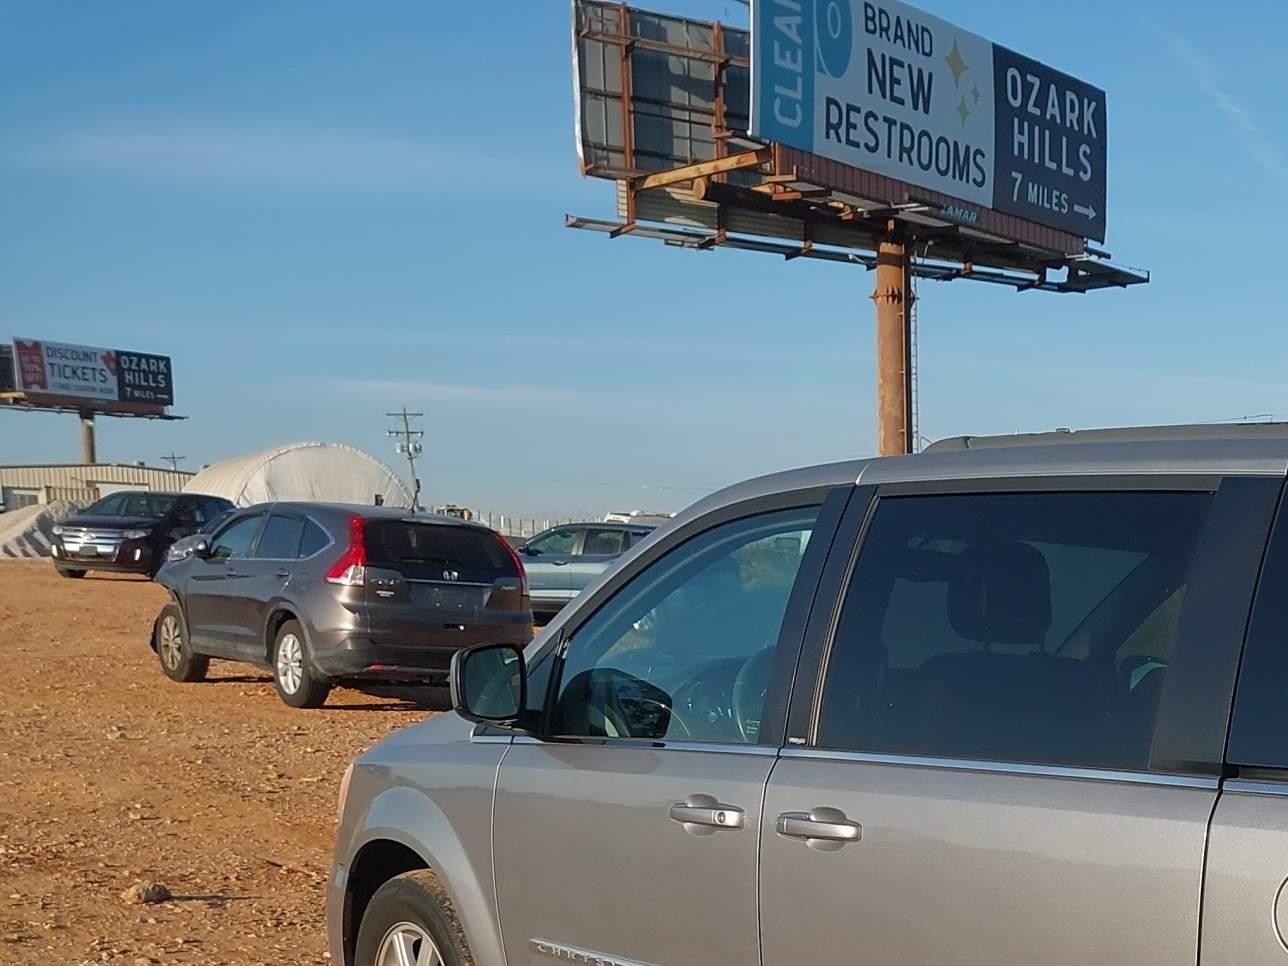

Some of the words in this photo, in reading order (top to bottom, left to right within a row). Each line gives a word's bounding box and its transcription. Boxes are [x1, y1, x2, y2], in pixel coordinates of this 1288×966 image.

[863, 2, 933, 57] BRAND
[866, 47, 933, 115] NEW
[1006, 67, 1097, 138] OZARK
[825, 96, 986, 188] RESTROOMS
[1013, 117, 1092, 181] HILLS
[1011, 171, 1023, 202] 7
[1028, 181, 1069, 214] MILES
[46, 346, 98, 363] DISCOUNT
[48, 362, 108, 383] TICKETS
[121, 355, 168, 373] OZARK
[125, 370, 166, 388] HILLS
[125, 387, 132, 398] 7
